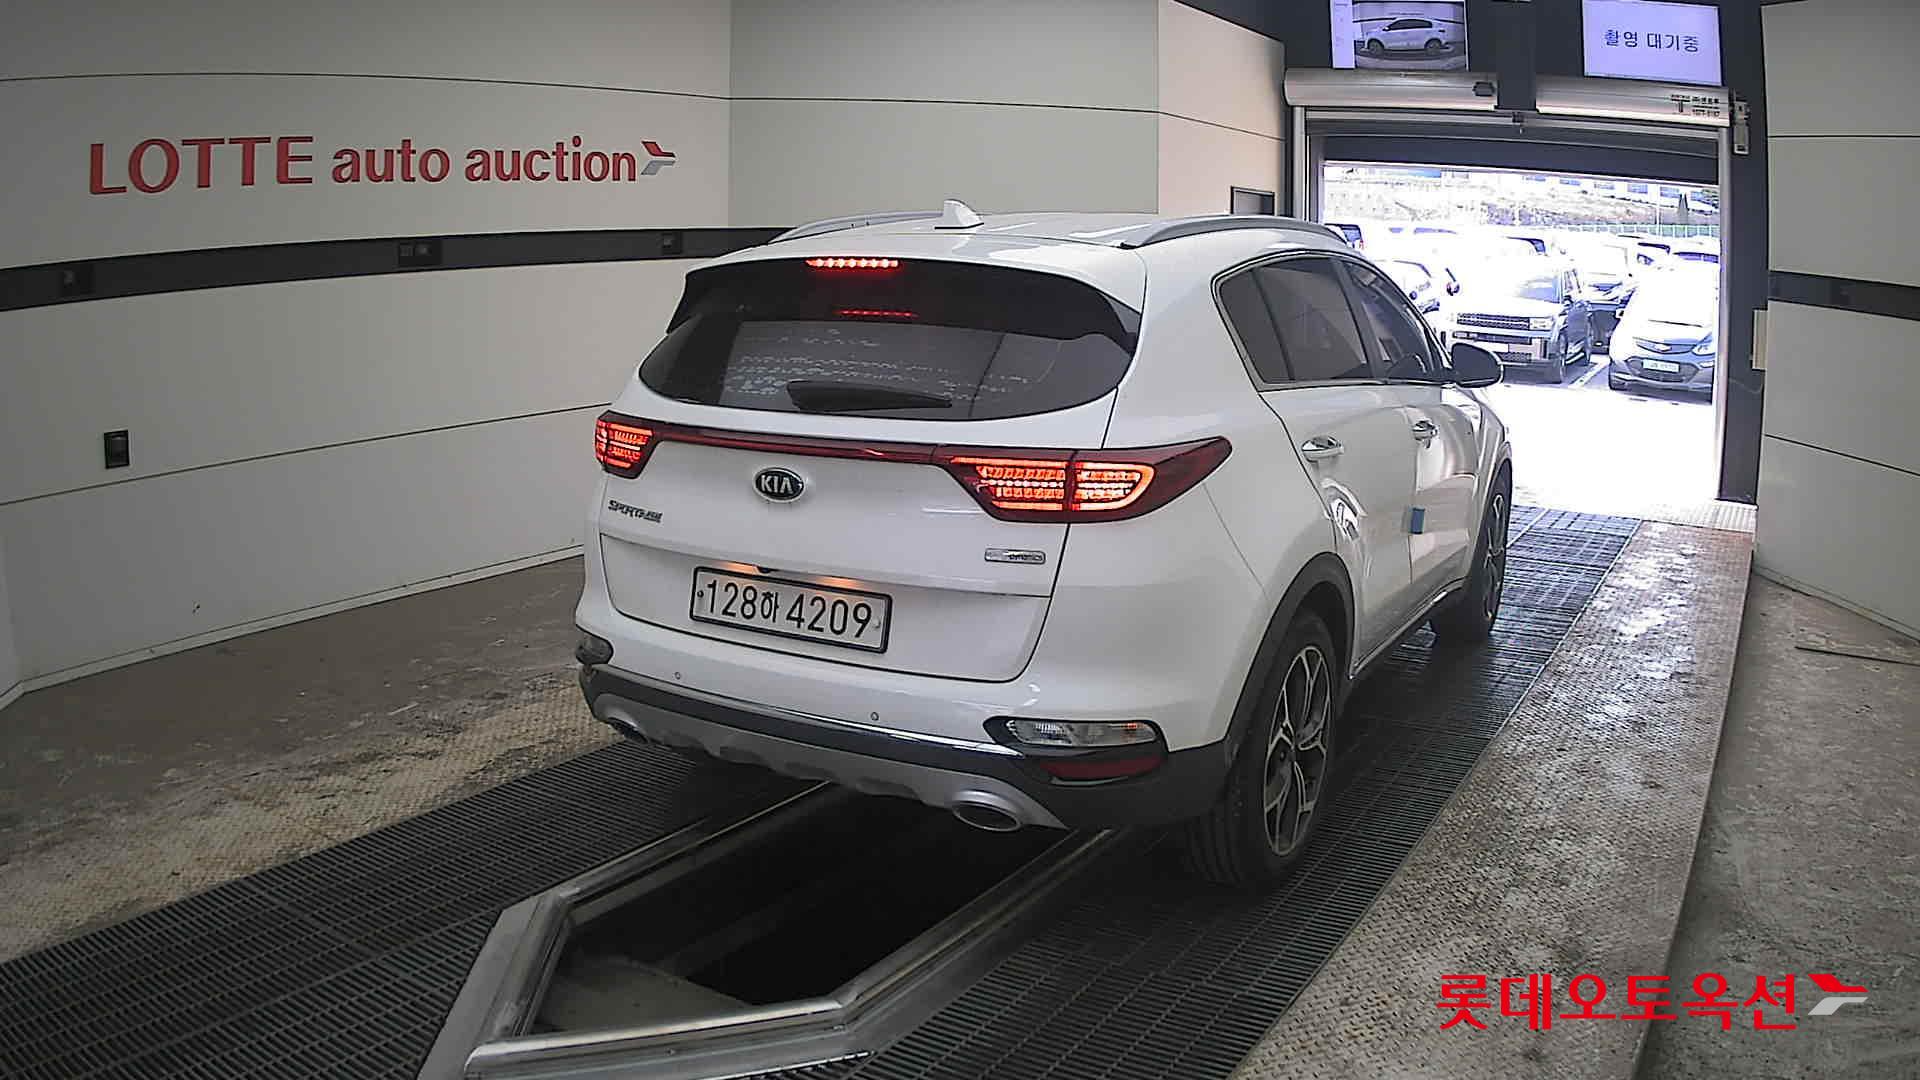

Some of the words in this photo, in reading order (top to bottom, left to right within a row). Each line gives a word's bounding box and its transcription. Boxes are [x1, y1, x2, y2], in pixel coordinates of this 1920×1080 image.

[1646, 33, 1699, 53] 대기중
[90, 136, 313, 195] LOTTE
[331, 138, 450, 183] auto
[464, 136, 637, 183] auction
[761, 474, 793, 494] KIA
[707, 579, 780, 623] 128하
[786, 593, 872, 638] 4209
